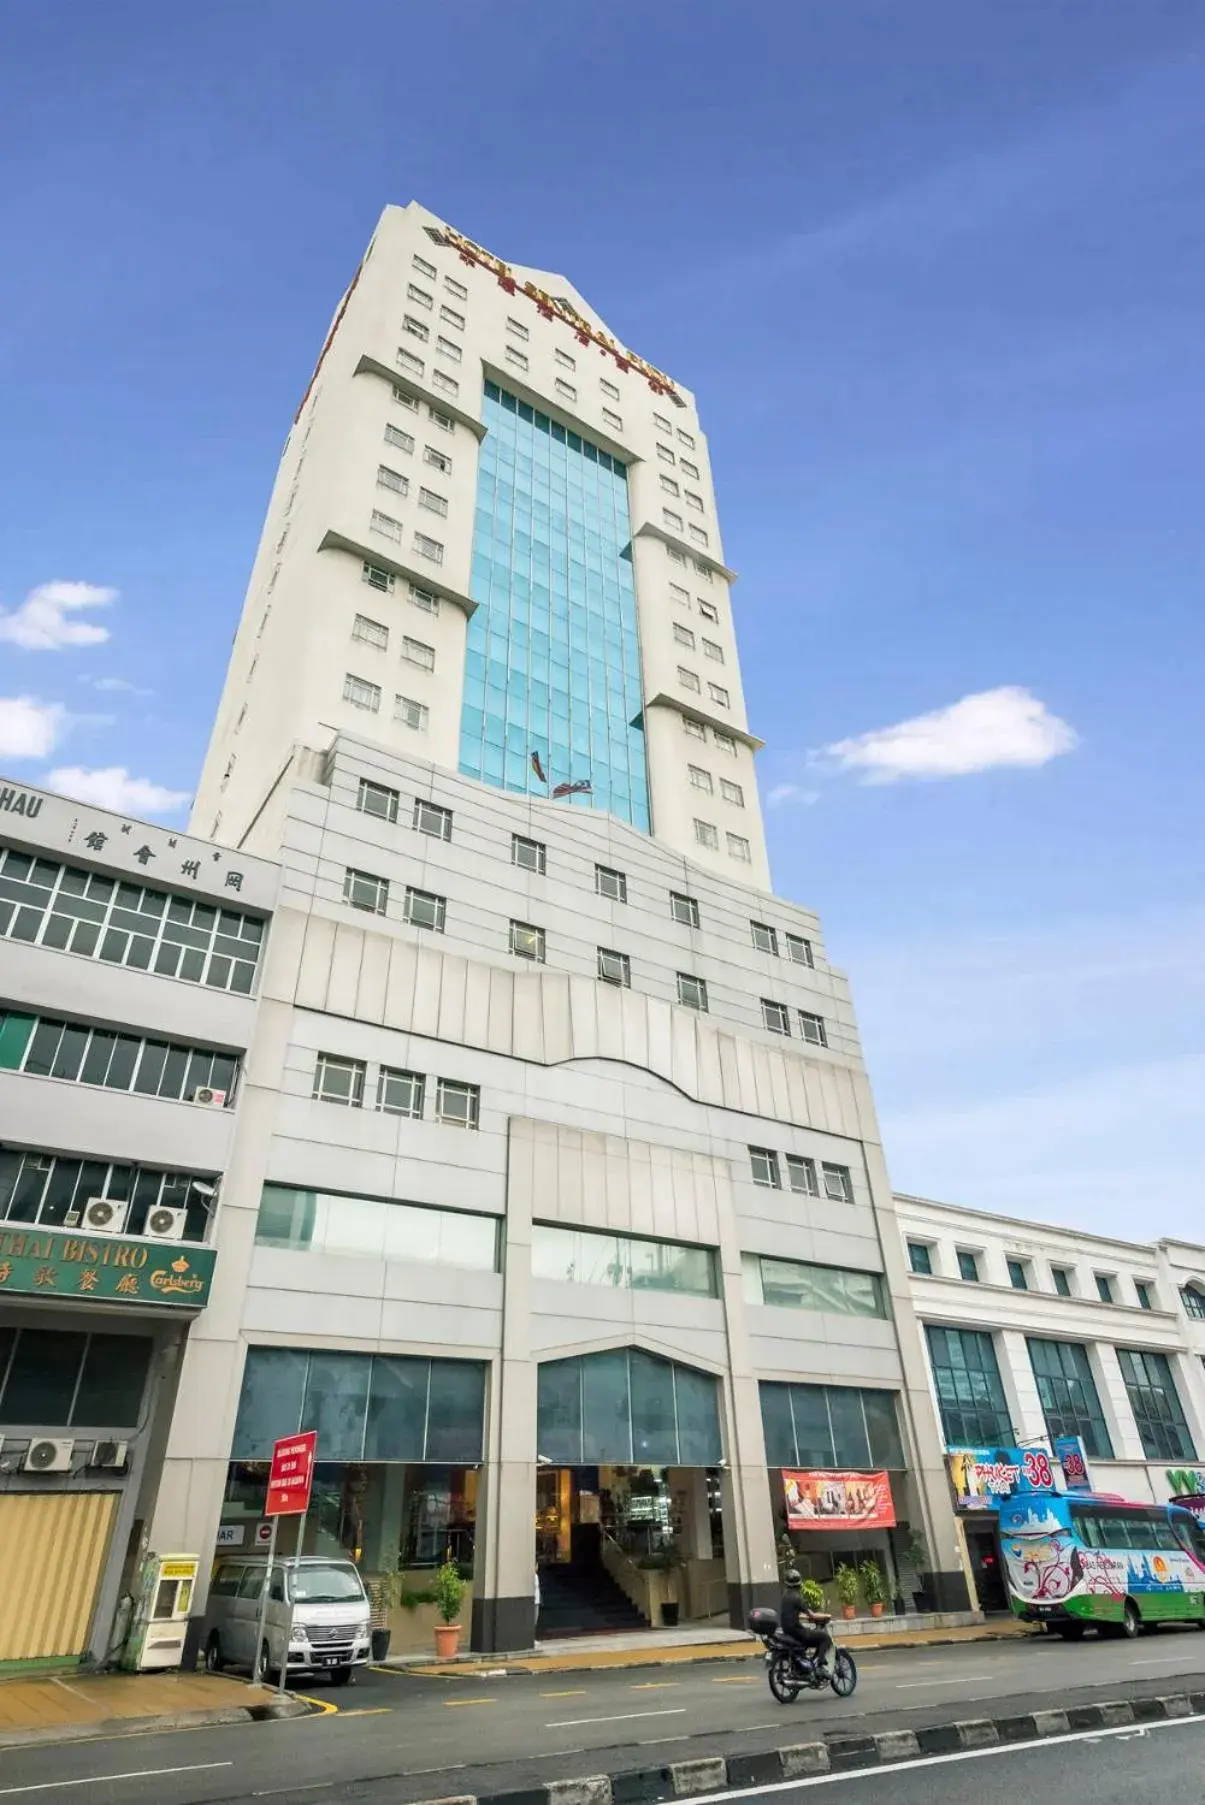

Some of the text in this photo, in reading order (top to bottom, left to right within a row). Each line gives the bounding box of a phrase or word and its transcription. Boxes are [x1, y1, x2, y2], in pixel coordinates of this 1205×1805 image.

[0, 787, 43, 818] HAU
[63, 1239, 148, 1269] BISTRO
[150, 1270, 203, 1293] Carlsberg
[1024, 1452, 1053, 1487] 38
[1064, 1453, 1084, 1475] 38
